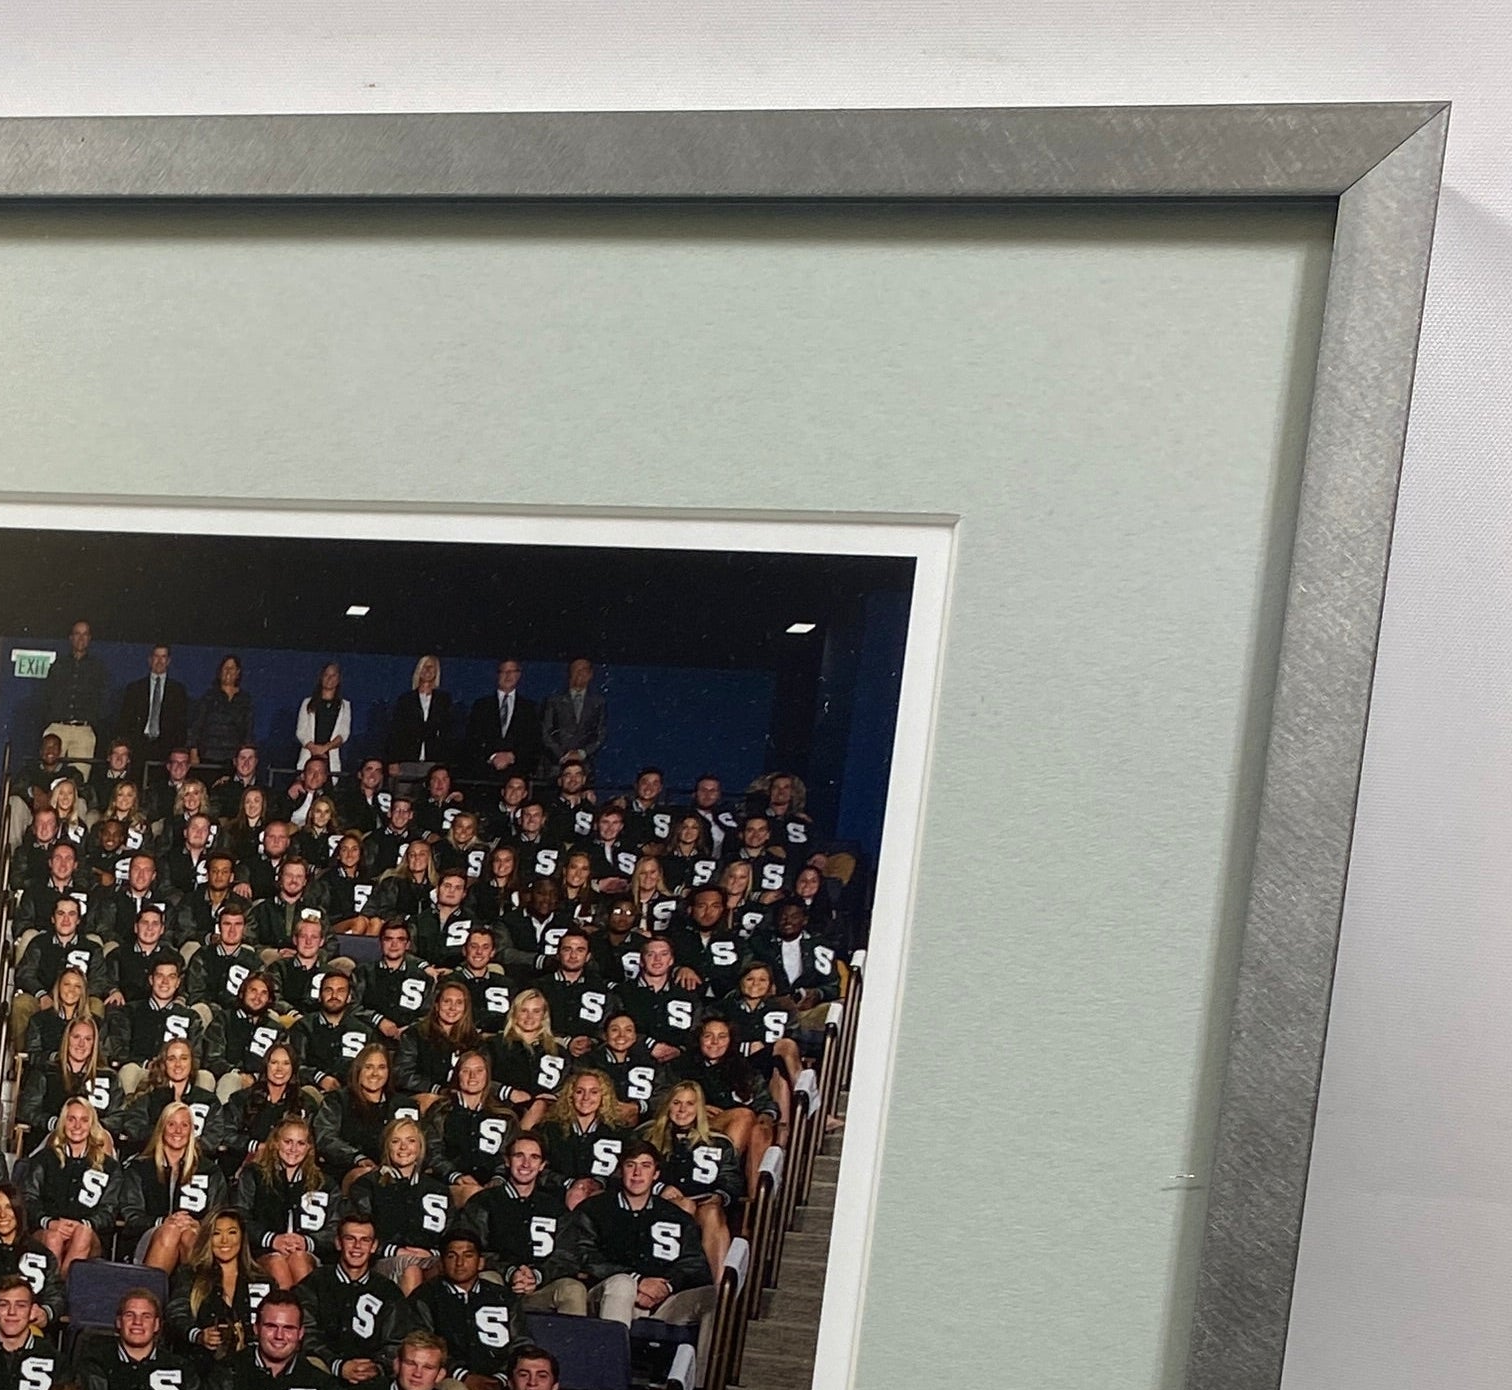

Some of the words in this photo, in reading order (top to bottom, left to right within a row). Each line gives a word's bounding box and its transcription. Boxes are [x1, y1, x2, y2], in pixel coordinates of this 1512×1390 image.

[18, 657, 47, 676] EXIT
[378, 792, 391, 812] S
[575, 811, 593, 834] S
[654, 814, 670, 837] S
[787, 822, 807, 843] S
[467, 851, 484, 877] S
[535, 850, 558, 875] S
[618, 853, 636, 874] S
[693, 861, 715, 885] S
[762, 864, 784, 890] S
[653, 901, 676, 931] S
[738, 912, 763, 937] S
[446, 920, 471, 946] S
[66, 951, 90, 974] S
[711, 942, 737, 965] S
[815, 947, 833, 974] S
[226, 964, 250, 996] S
[400, 979, 425, 1009] S
[486, 988, 509, 1012] S
[580, 992, 605, 1022] S
[668, 1001, 691, 1028] S
[164, 1015, 190, 1042] S
[250, 1027, 277, 1056] S
[764, 1012, 787, 1042] S
[342, 1032, 366, 1058] S
[538, 1055, 563, 1088] S
[628, 1067, 654, 1099] S
[86, 1078, 110, 1109] S
[479, 1119, 506, 1154] S
[591, 1139, 621, 1176] S
[692, 1146, 722, 1184] S
[79, 1170, 108, 1207] S
[179, 1175, 208, 1212] S
[301, 1191, 328, 1231] S
[422, 1194, 448, 1232] S
[530, 1217, 556, 1257] S
[652, 1222, 680, 1260] S
[19, 1253, 46, 1293] S
[353, 1294, 382, 1338] S
[475, 1307, 509, 1347] S
